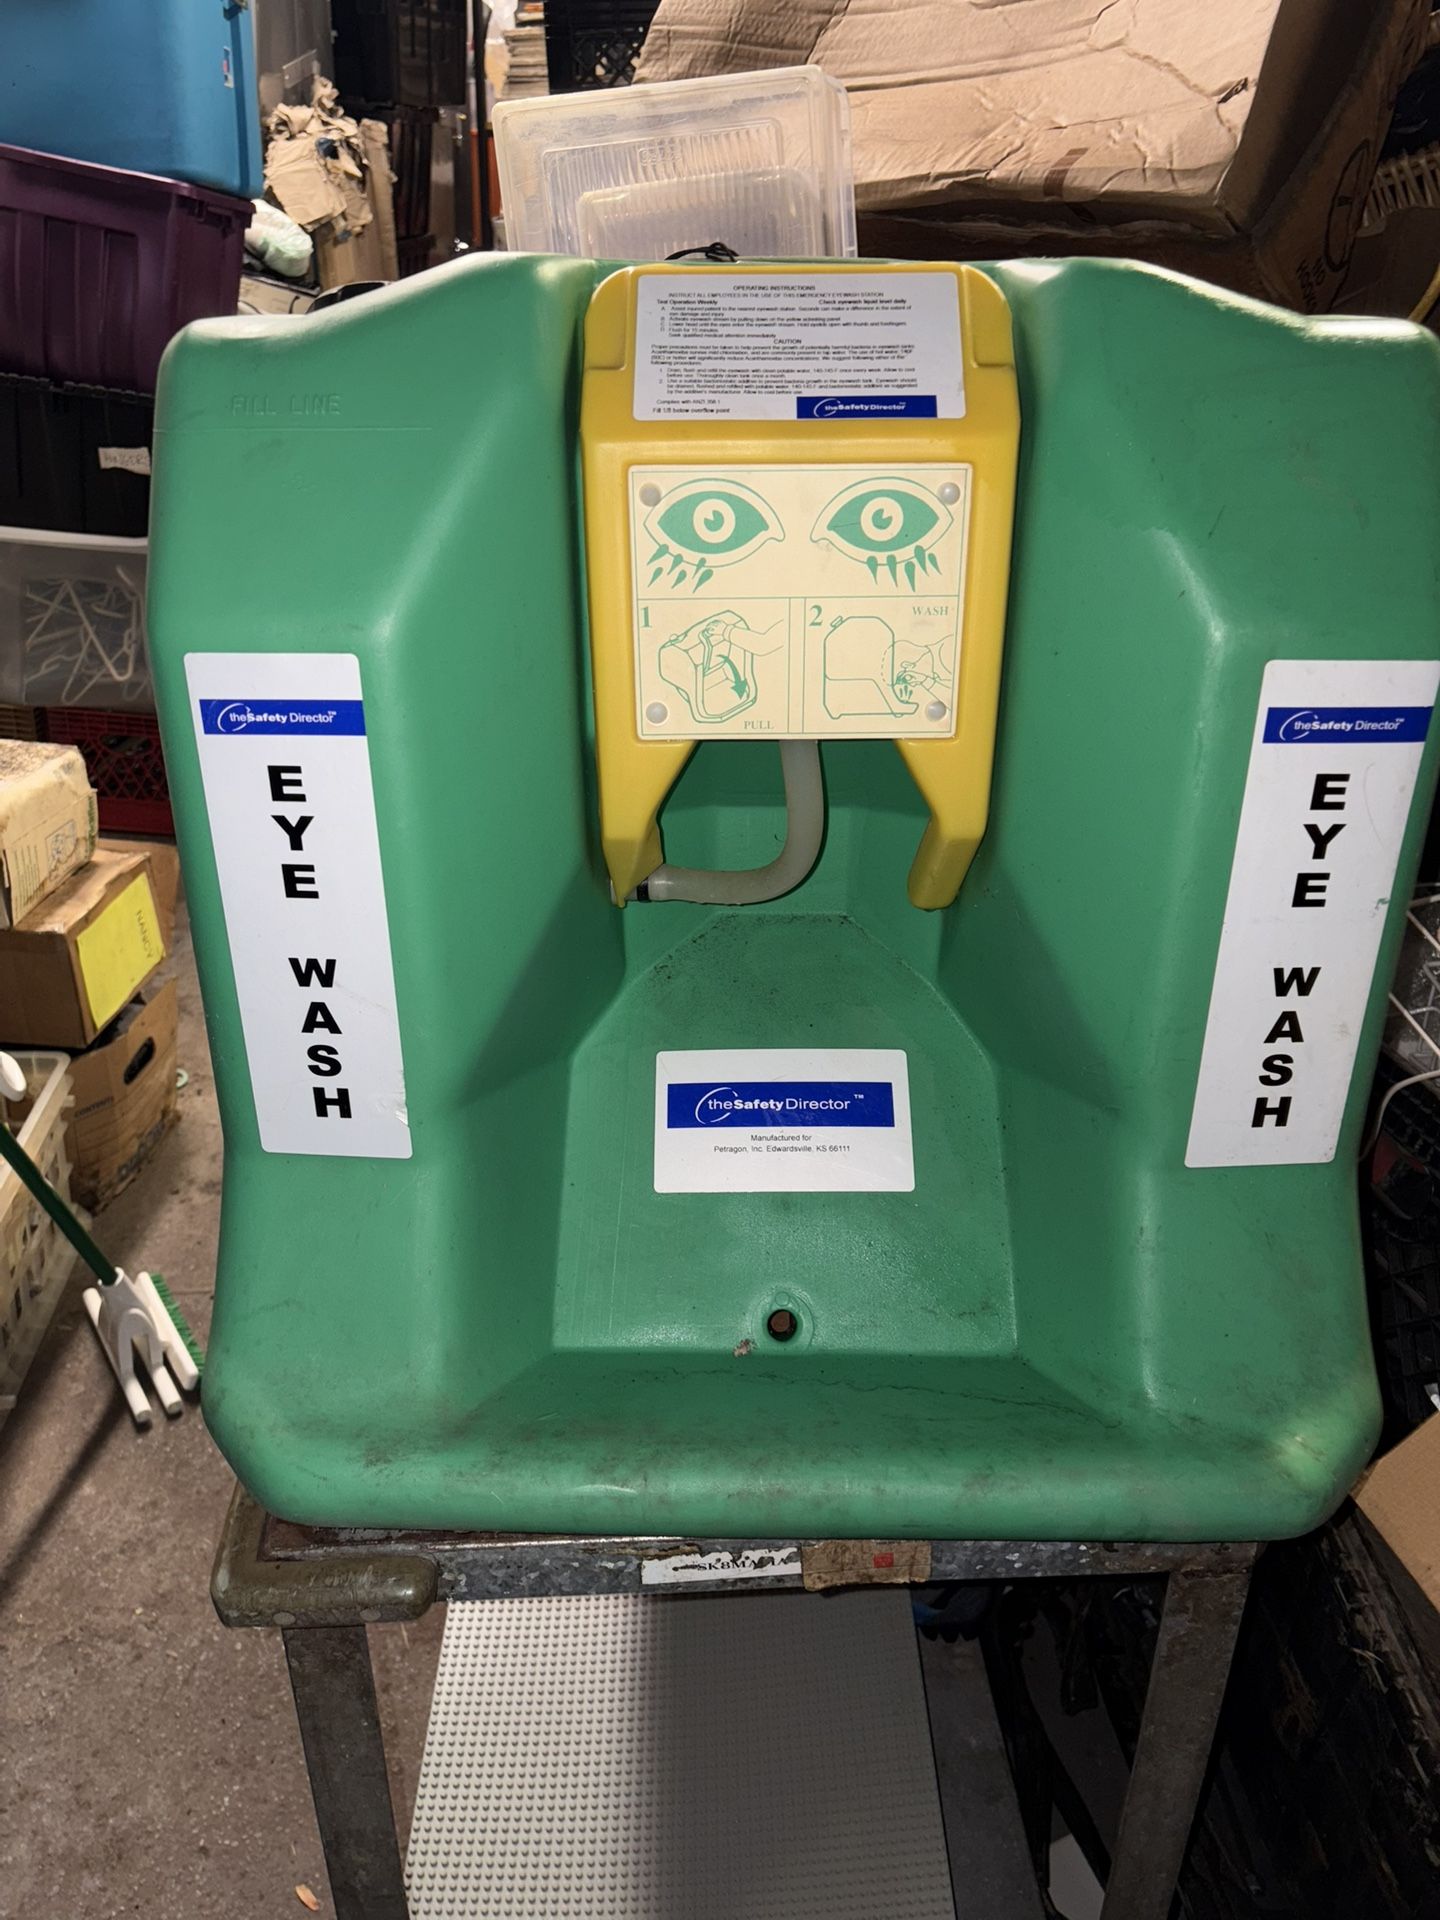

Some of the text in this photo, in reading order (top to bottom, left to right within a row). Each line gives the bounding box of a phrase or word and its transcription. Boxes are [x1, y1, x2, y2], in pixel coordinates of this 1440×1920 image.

[232, 394, 342, 416] FILL LINE
[640, 606, 652, 628] 1
[808, 605, 823, 627] 2
[912, 605, 949, 617] WASH
[743, 720, 775, 730] PULL
[268, 766, 351, 1118] EYE WASH
[1252, 774, 1350, 1127] EYE WASH
[751, 1134, 812, 1142] Manufactured for
